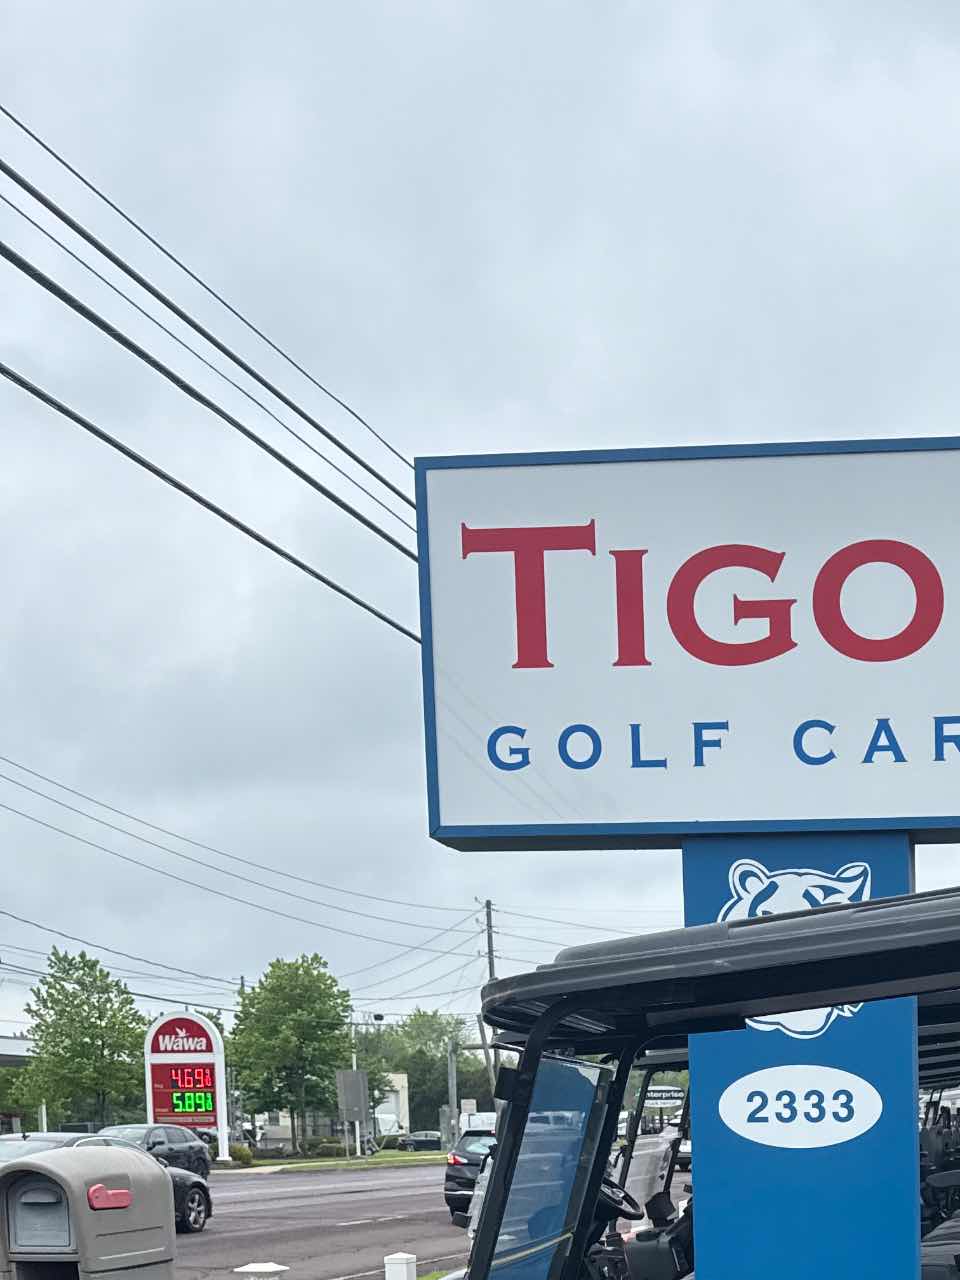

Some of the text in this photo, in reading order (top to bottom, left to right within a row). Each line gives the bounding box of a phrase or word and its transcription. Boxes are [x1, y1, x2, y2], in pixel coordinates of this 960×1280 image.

[486, 719, 730, 771] GOLF
[158, 1034, 207, 1051] Wawa
[645, 1091, 685, 1099] nterprise
[746, 1089, 855, 1123] 2333
